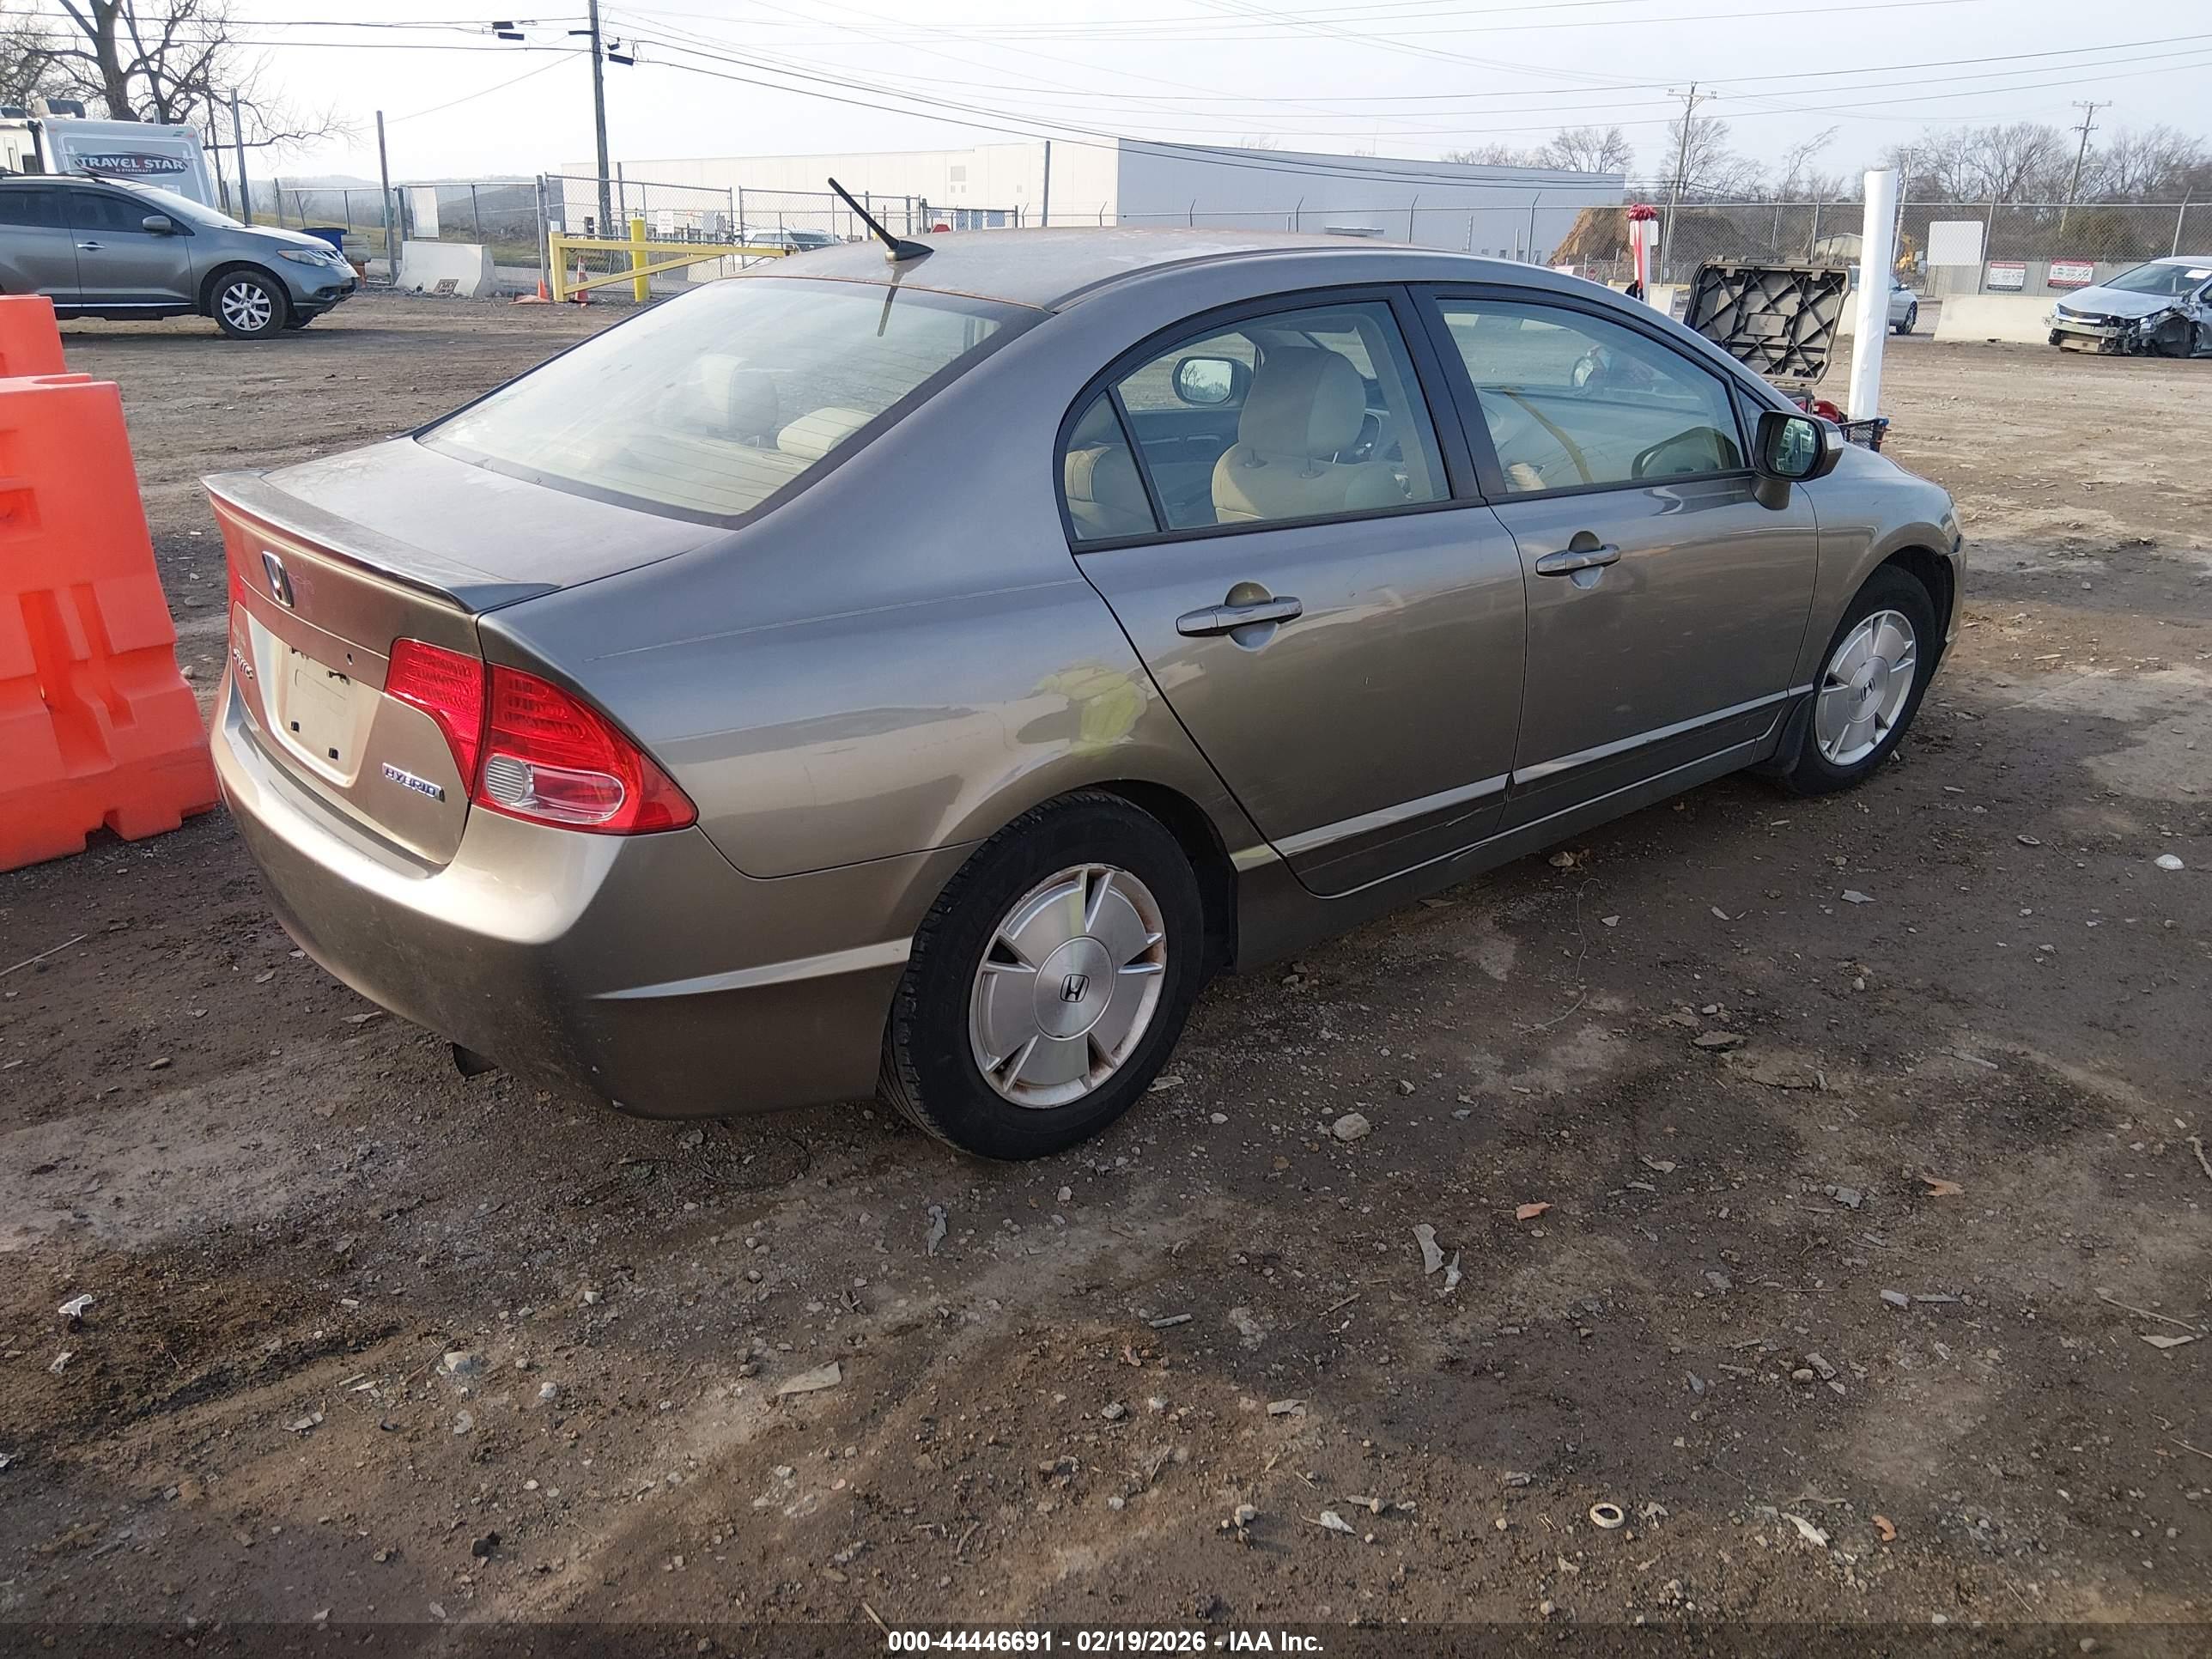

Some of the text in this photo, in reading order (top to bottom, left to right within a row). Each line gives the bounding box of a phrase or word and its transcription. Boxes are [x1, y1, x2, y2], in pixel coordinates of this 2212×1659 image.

[82, 157, 185, 170] TRAVEL STAR
[384, 766, 437, 799] HYBRID
